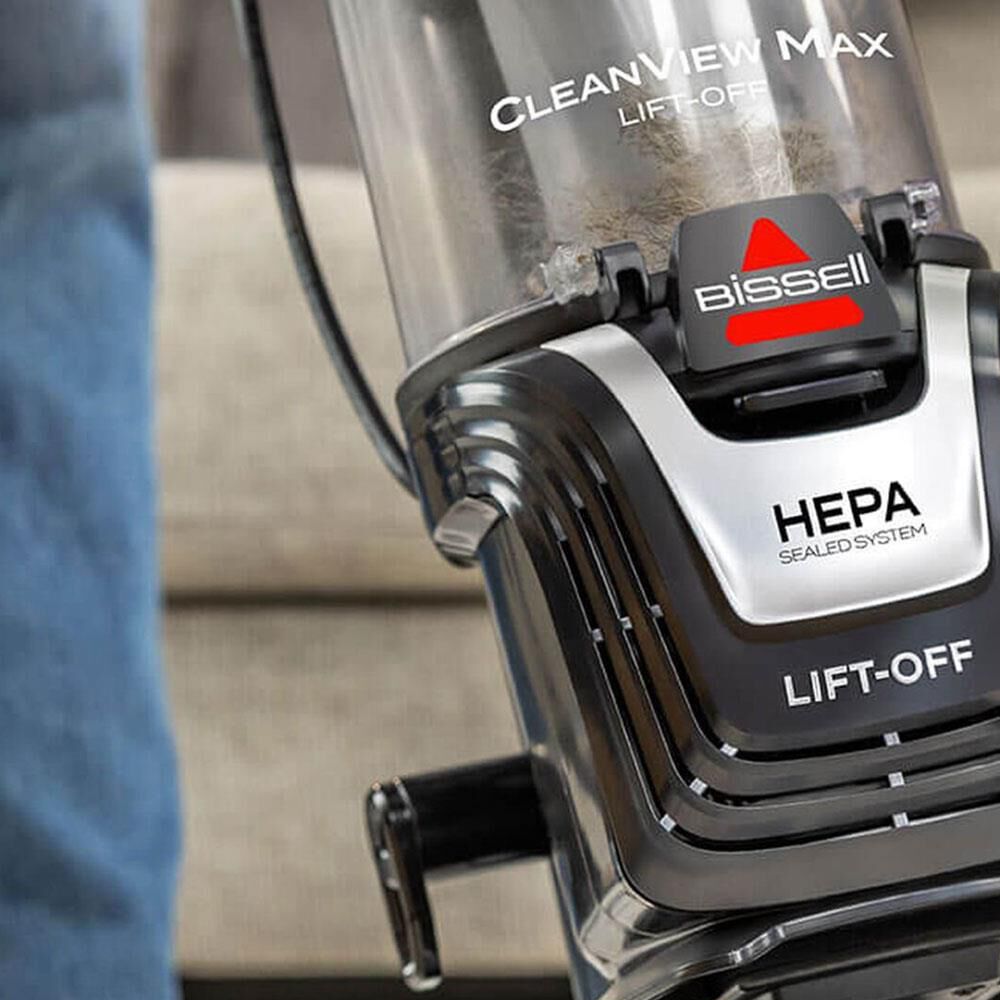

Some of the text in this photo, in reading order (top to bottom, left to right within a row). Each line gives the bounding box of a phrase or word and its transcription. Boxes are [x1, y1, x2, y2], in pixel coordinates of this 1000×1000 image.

[490, 27, 894, 132] CLEANVIEW MAX
[617, 80, 767, 127] LIFT-OFF
[772, 480, 921, 543] HEPA
[778, 523, 928, 565] SEALED SYSTEM
[783, 639, 974, 707] LIFT-OFF
